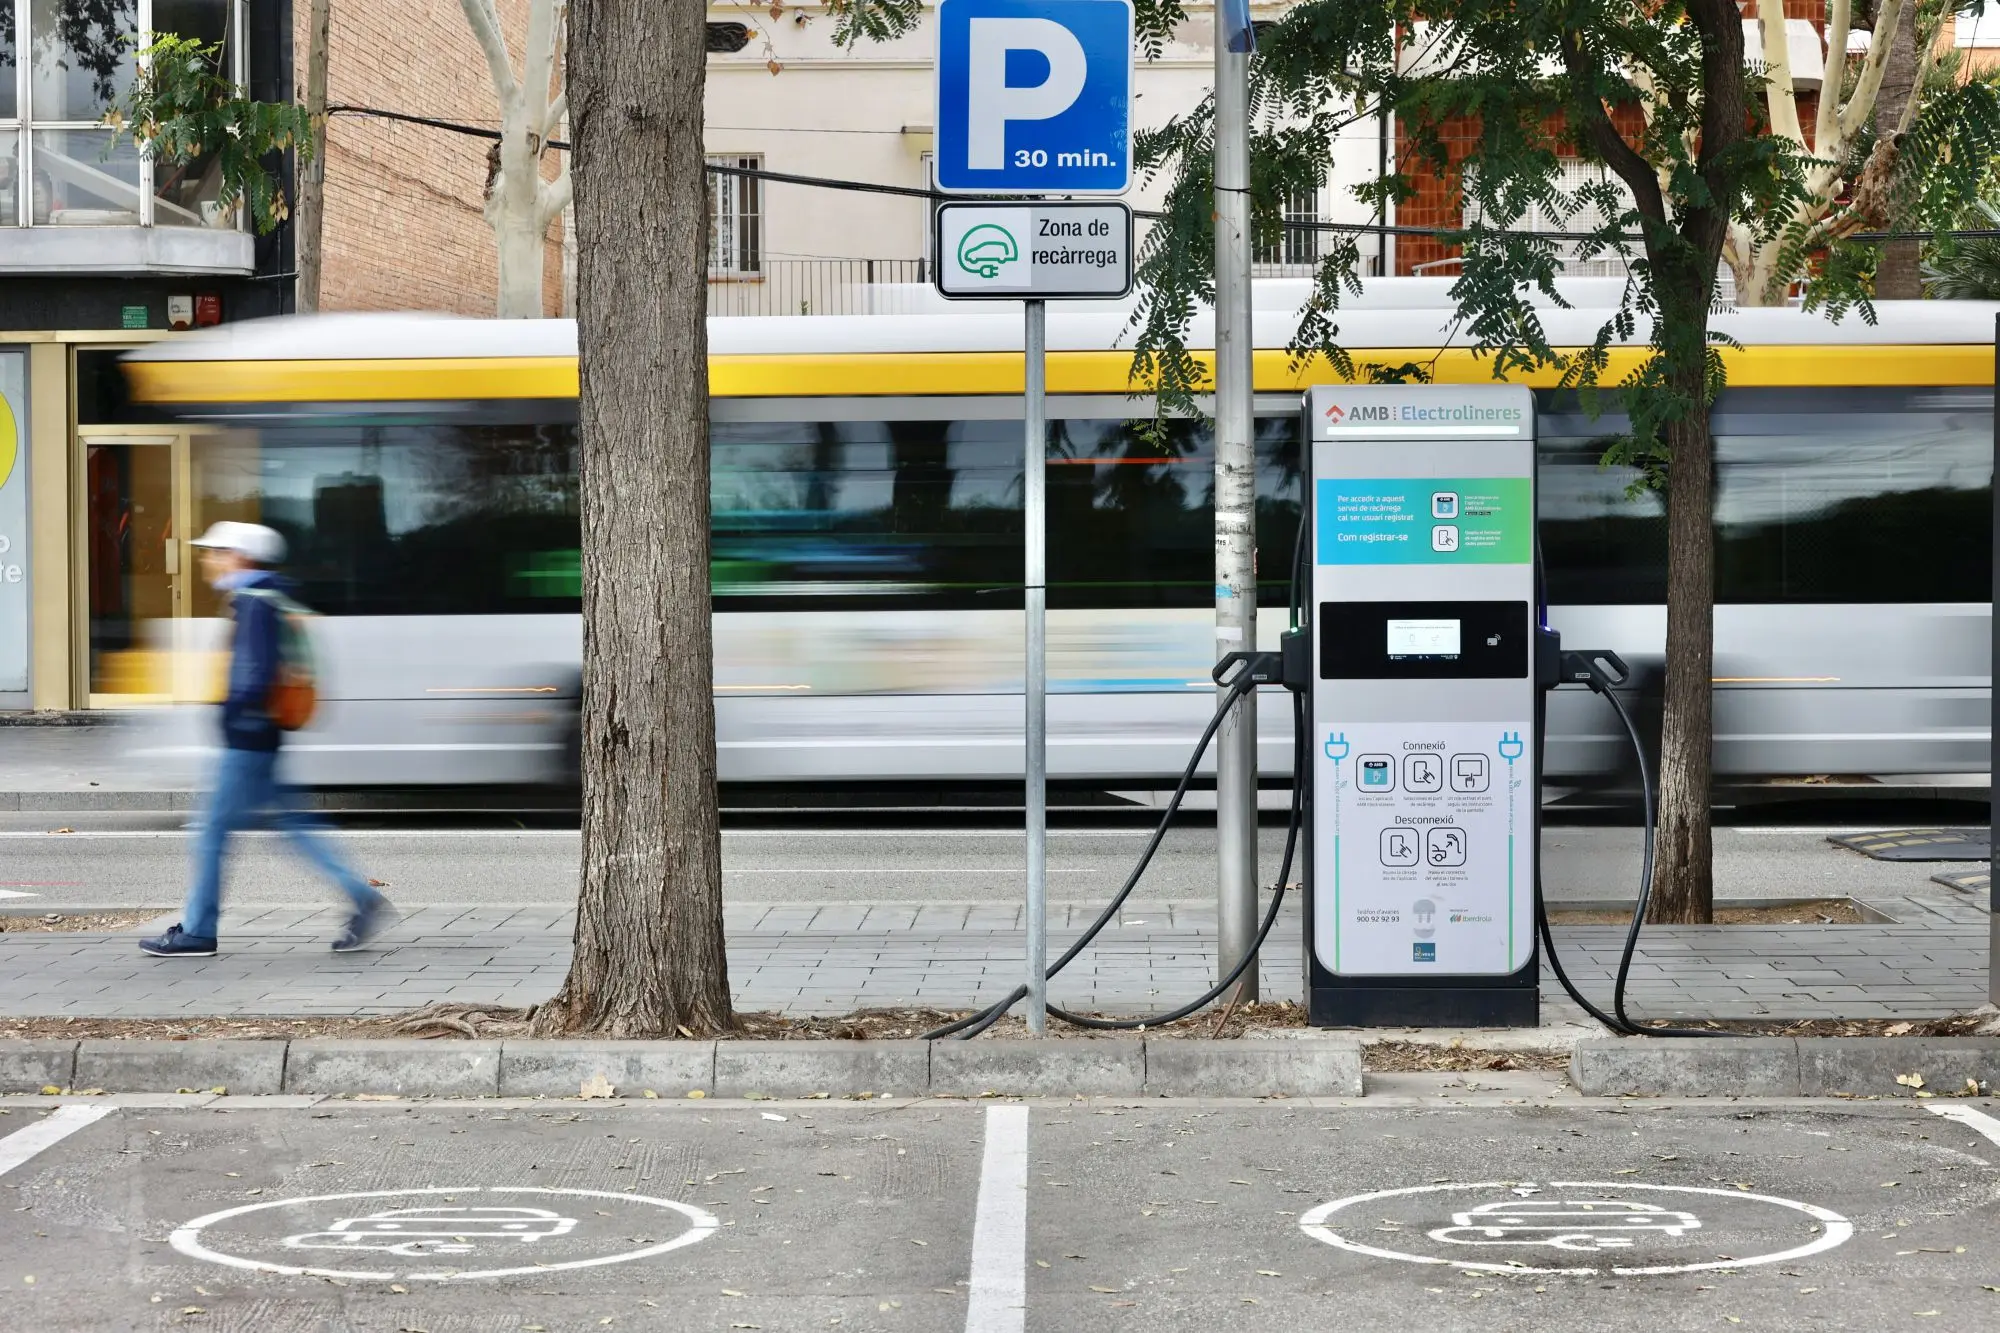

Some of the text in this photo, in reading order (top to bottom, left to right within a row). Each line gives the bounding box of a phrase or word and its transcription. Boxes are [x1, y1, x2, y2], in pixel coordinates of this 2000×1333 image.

[968, 17, 1087, 170] P
[1014, 149, 1116, 168] 30 min.
[1039, 219, 1109, 237] Zona de
[1032, 246, 1117, 268] recàrrega
[1349, 405, 1521, 421] AMB Electrolineres
[1370, 504, 1401, 513] recàrrega
[1384, 514, 1414, 522] registrat
[1337, 533, 1409, 543] Com registrar-se
[1403, 741, 1446, 751] Connexió
[1395, 814, 1454, 824] Desconnexió
